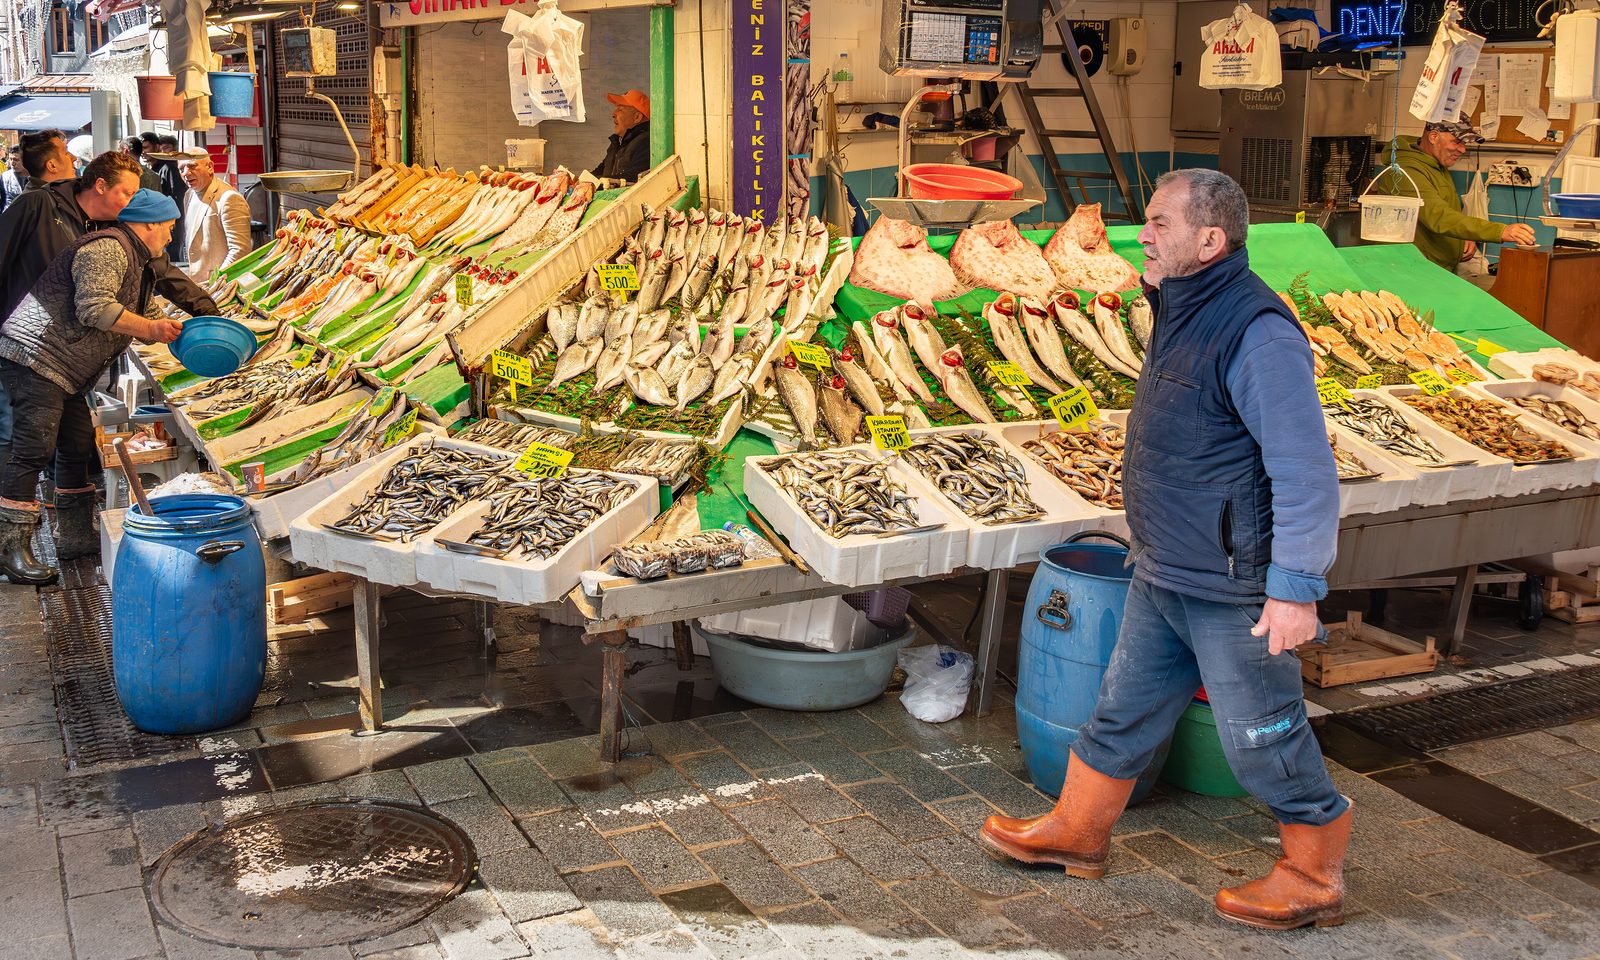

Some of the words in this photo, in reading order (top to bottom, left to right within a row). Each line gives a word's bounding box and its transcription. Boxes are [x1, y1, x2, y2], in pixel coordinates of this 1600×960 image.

[1244, 91, 1281, 102] BREMA
[751, 75, 765, 219] BALIKÇILIK
[604, 276, 629, 289] 500
[497, 363, 520, 380] 500
[1320, 388, 1344, 402] 250
[1059, 402, 1087, 424] 600
[880, 432, 904, 448] 350
[525, 460, 559, 478] 250
